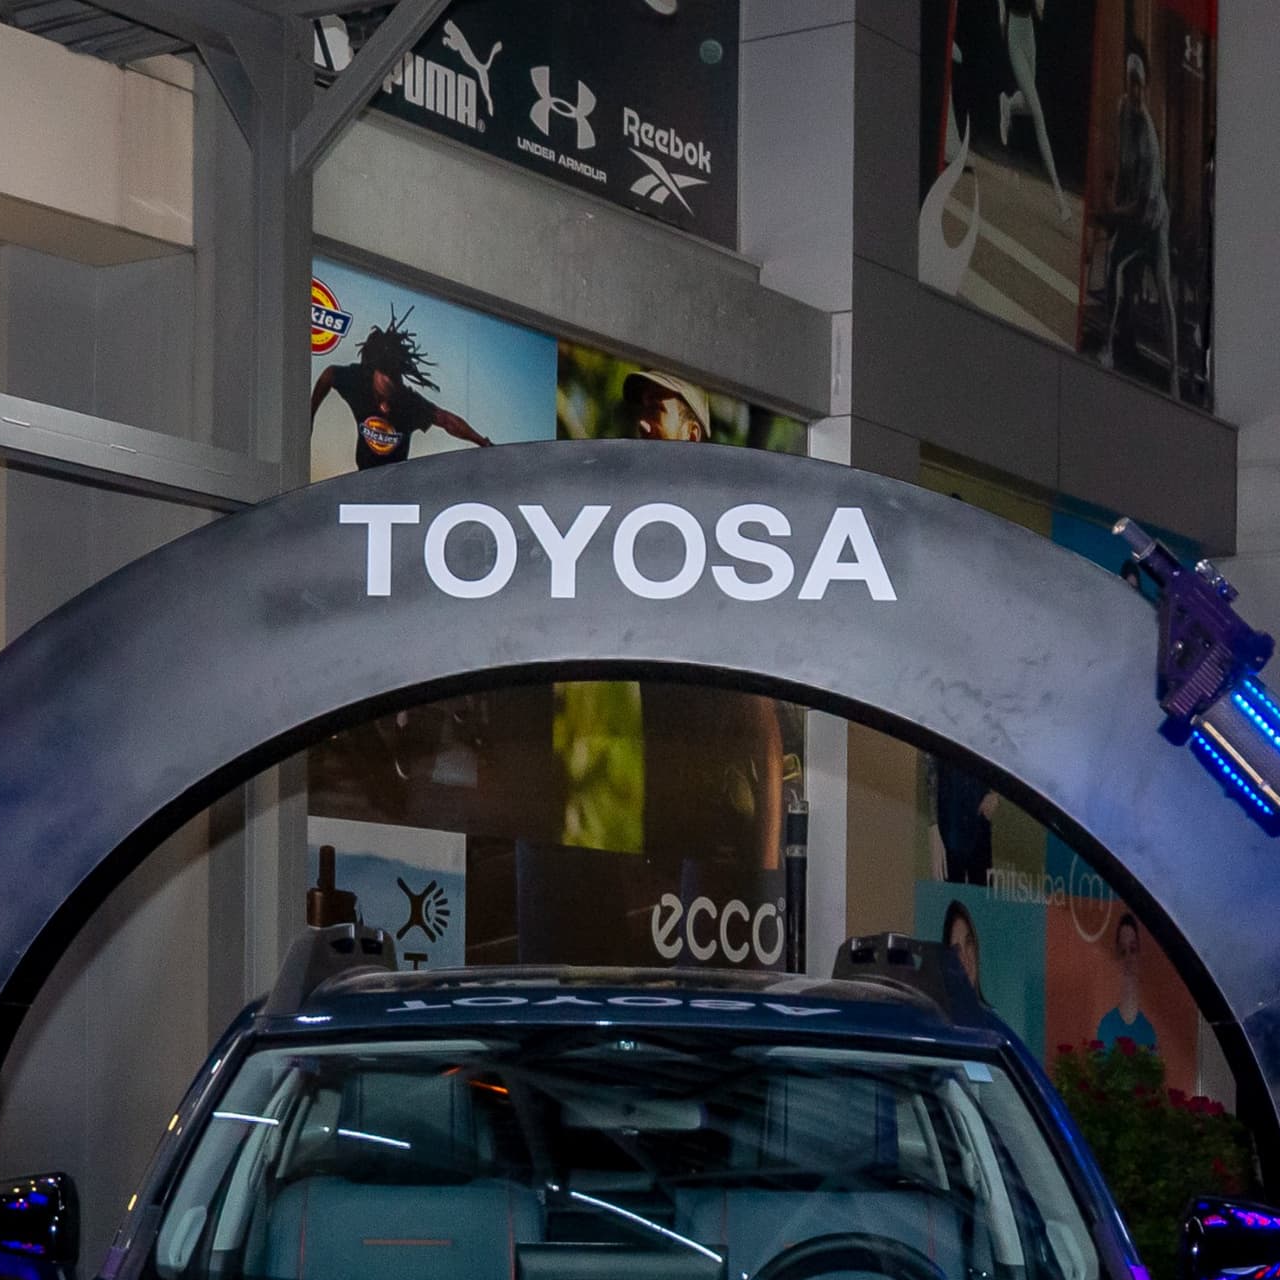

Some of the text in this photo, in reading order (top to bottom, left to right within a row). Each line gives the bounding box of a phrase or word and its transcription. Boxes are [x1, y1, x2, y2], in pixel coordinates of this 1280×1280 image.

[517, 136, 608, 184] UNDER ARMOUR
[623, 107, 712, 174] Reebok
[338, 502, 898, 601] TOYOSA
[987, 866, 1065, 907] mitsuba
[651, 892, 784, 966] ecco
